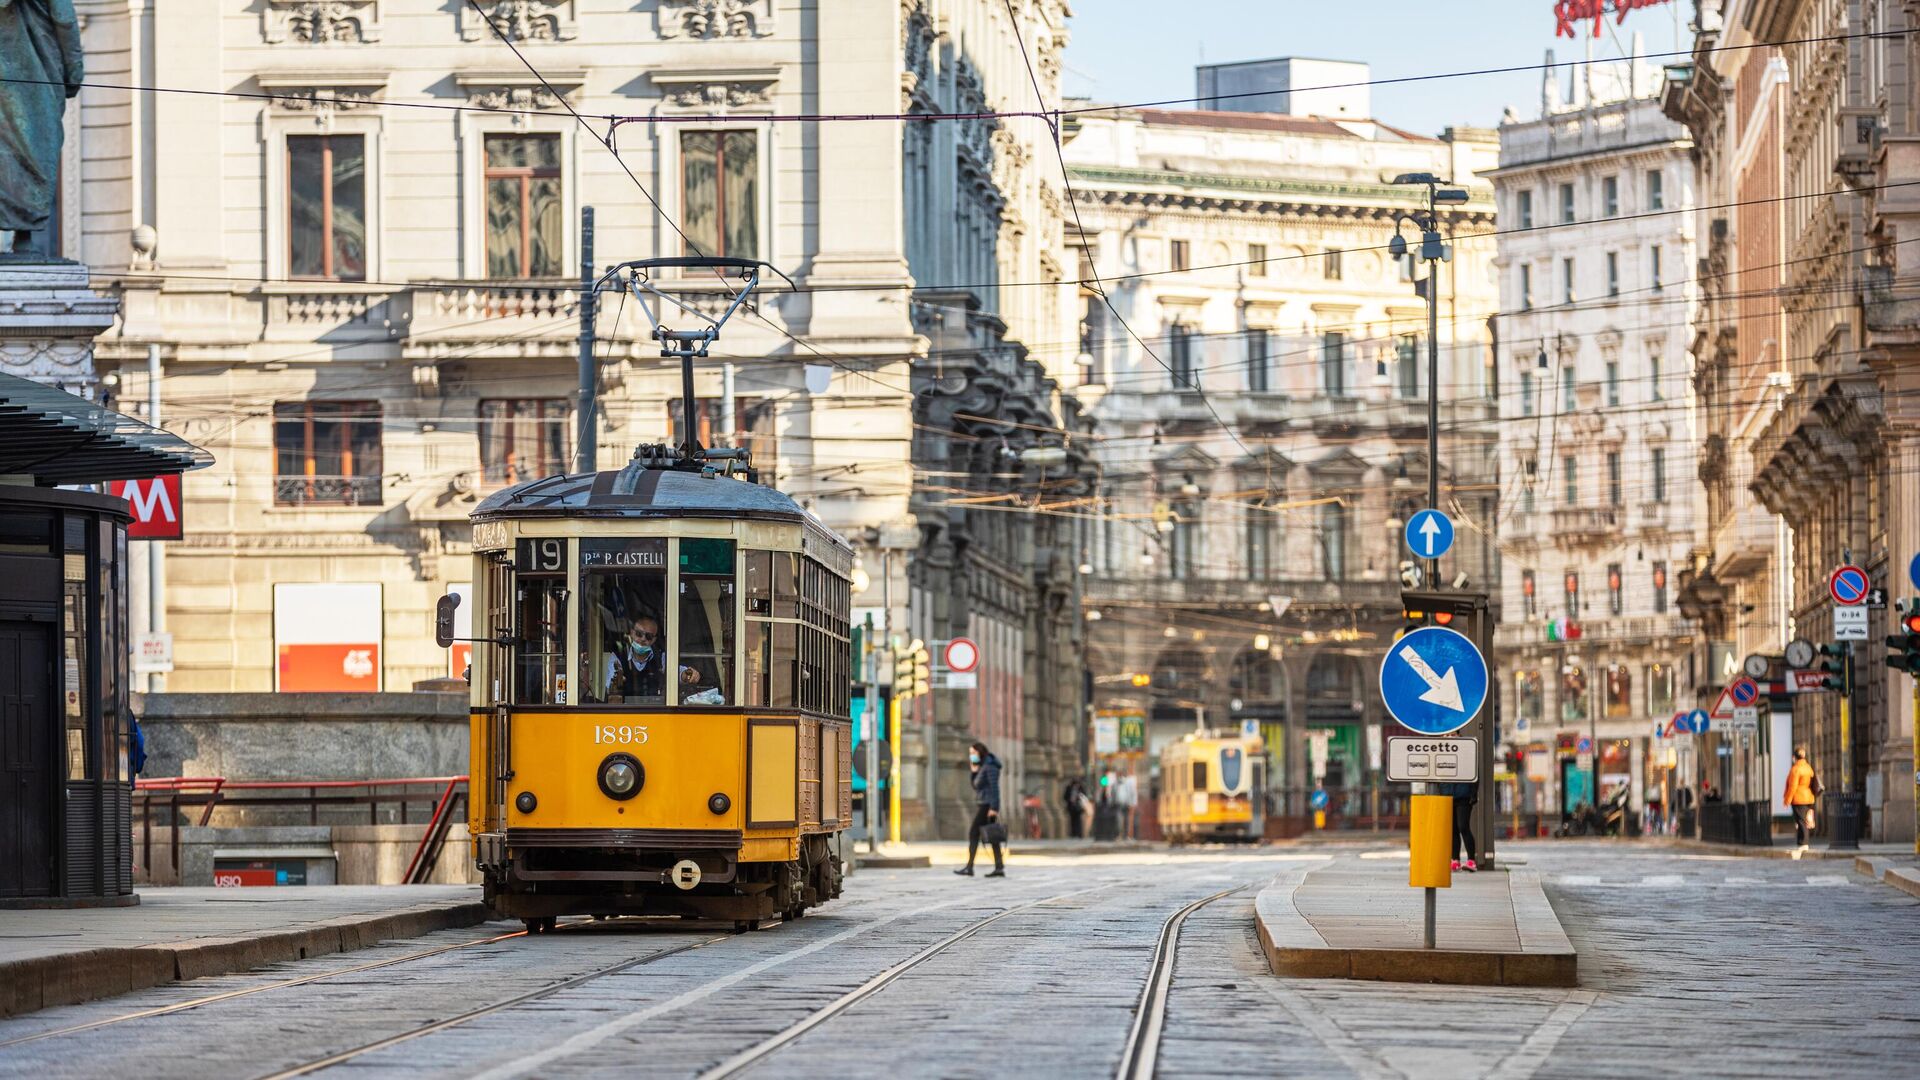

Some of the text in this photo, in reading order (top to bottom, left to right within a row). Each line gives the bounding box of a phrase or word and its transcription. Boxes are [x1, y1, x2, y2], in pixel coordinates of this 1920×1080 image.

[528, 539, 562, 570] 19
[605, 552, 613, 565] P.
[616, 552, 664, 566] CASTELLI
[594, 725, 650, 744] 1895
[1406, 742, 1459, 752] eccetto
